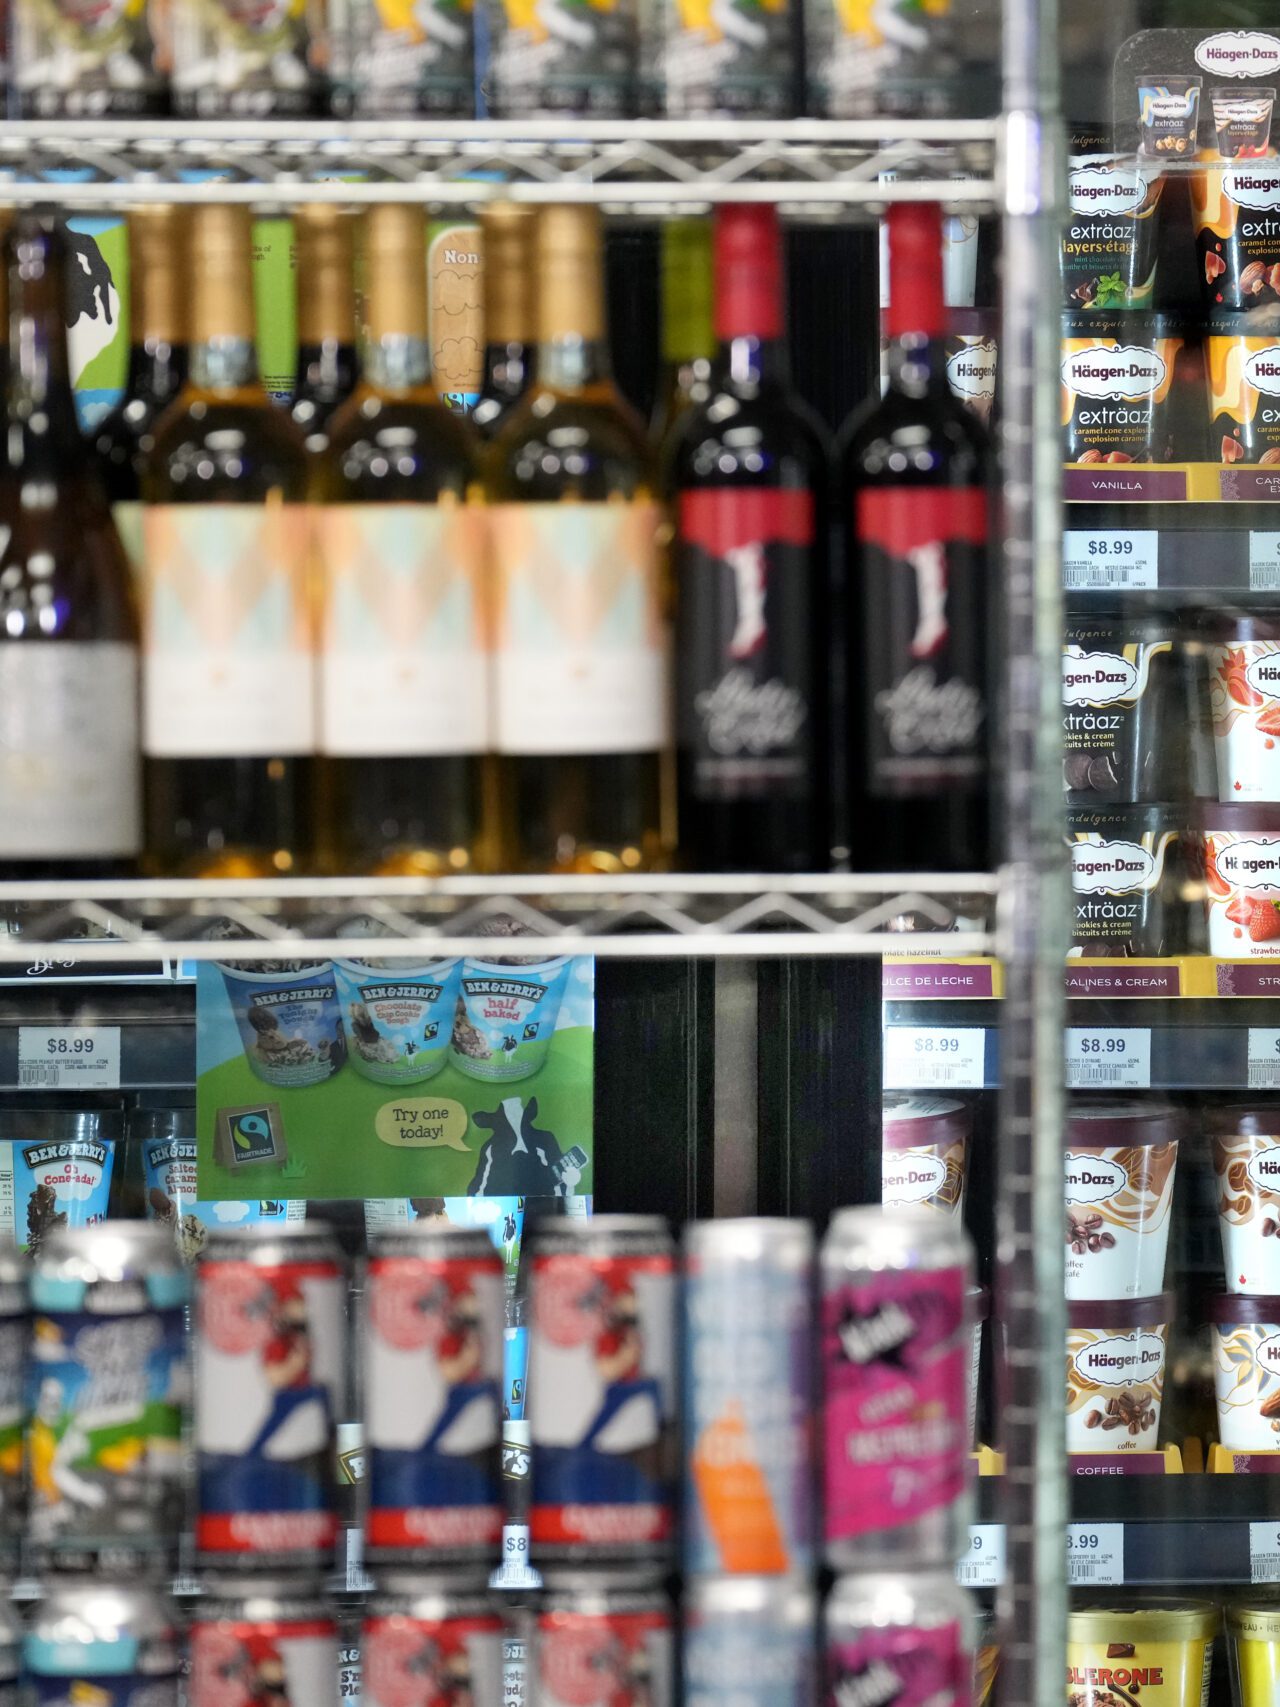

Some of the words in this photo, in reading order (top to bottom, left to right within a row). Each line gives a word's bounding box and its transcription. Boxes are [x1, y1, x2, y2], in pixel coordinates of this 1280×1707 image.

[1206, 48, 1278, 61] Häagen-Dazs
[1070, 223, 1133, 239] exträaz
[1238, 239, 1265, 247] caramel
[1247, 247, 1278, 255] explosion
[1072, 365, 1158, 381] Häagen-Dazs
[1078, 405, 1151, 425] exträaz
[1083, 435, 1113, 444] explosion
[1092, 481, 1142, 490] VANILLA
[1088, 540, 1133, 555] $8.99
[1063, 713, 1121, 730] xträaz
[1092, 740, 1115, 748] crème
[1074, 901, 1137, 918] xträaz
[1110, 928, 1132, 936] crème
[881, 977, 911, 986] ULCE
[916, 977, 931, 985] DE
[935, 976, 973, 985] LECHE
[1064, 978, 1112, 986] RALINES
[1115, 978, 1122, 986] &
[1125, 978, 1167, 986] CREAM
[488, 997, 519, 1010] half
[483, 1009, 520, 1021] baked
[47, 1038, 94, 1053] $8.99
[914, 1038, 959, 1052] $8.99
[1081, 1038, 1126, 1053] $8.99
[393, 1109, 417, 1123] Try
[424, 1109, 449, 1120] one
[400, 1124, 443, 1139] today!
[237, 1147, 274, 1160] FAIRTRADE
[1088, 1350, 1161, 1370] Häagen-Dazs
[1117, 1441, 1137, 1450] coffee
[1076, 1466, 1124, 1475] COFFEE
[1067, 1667, 1163, 1685] BLERONE
